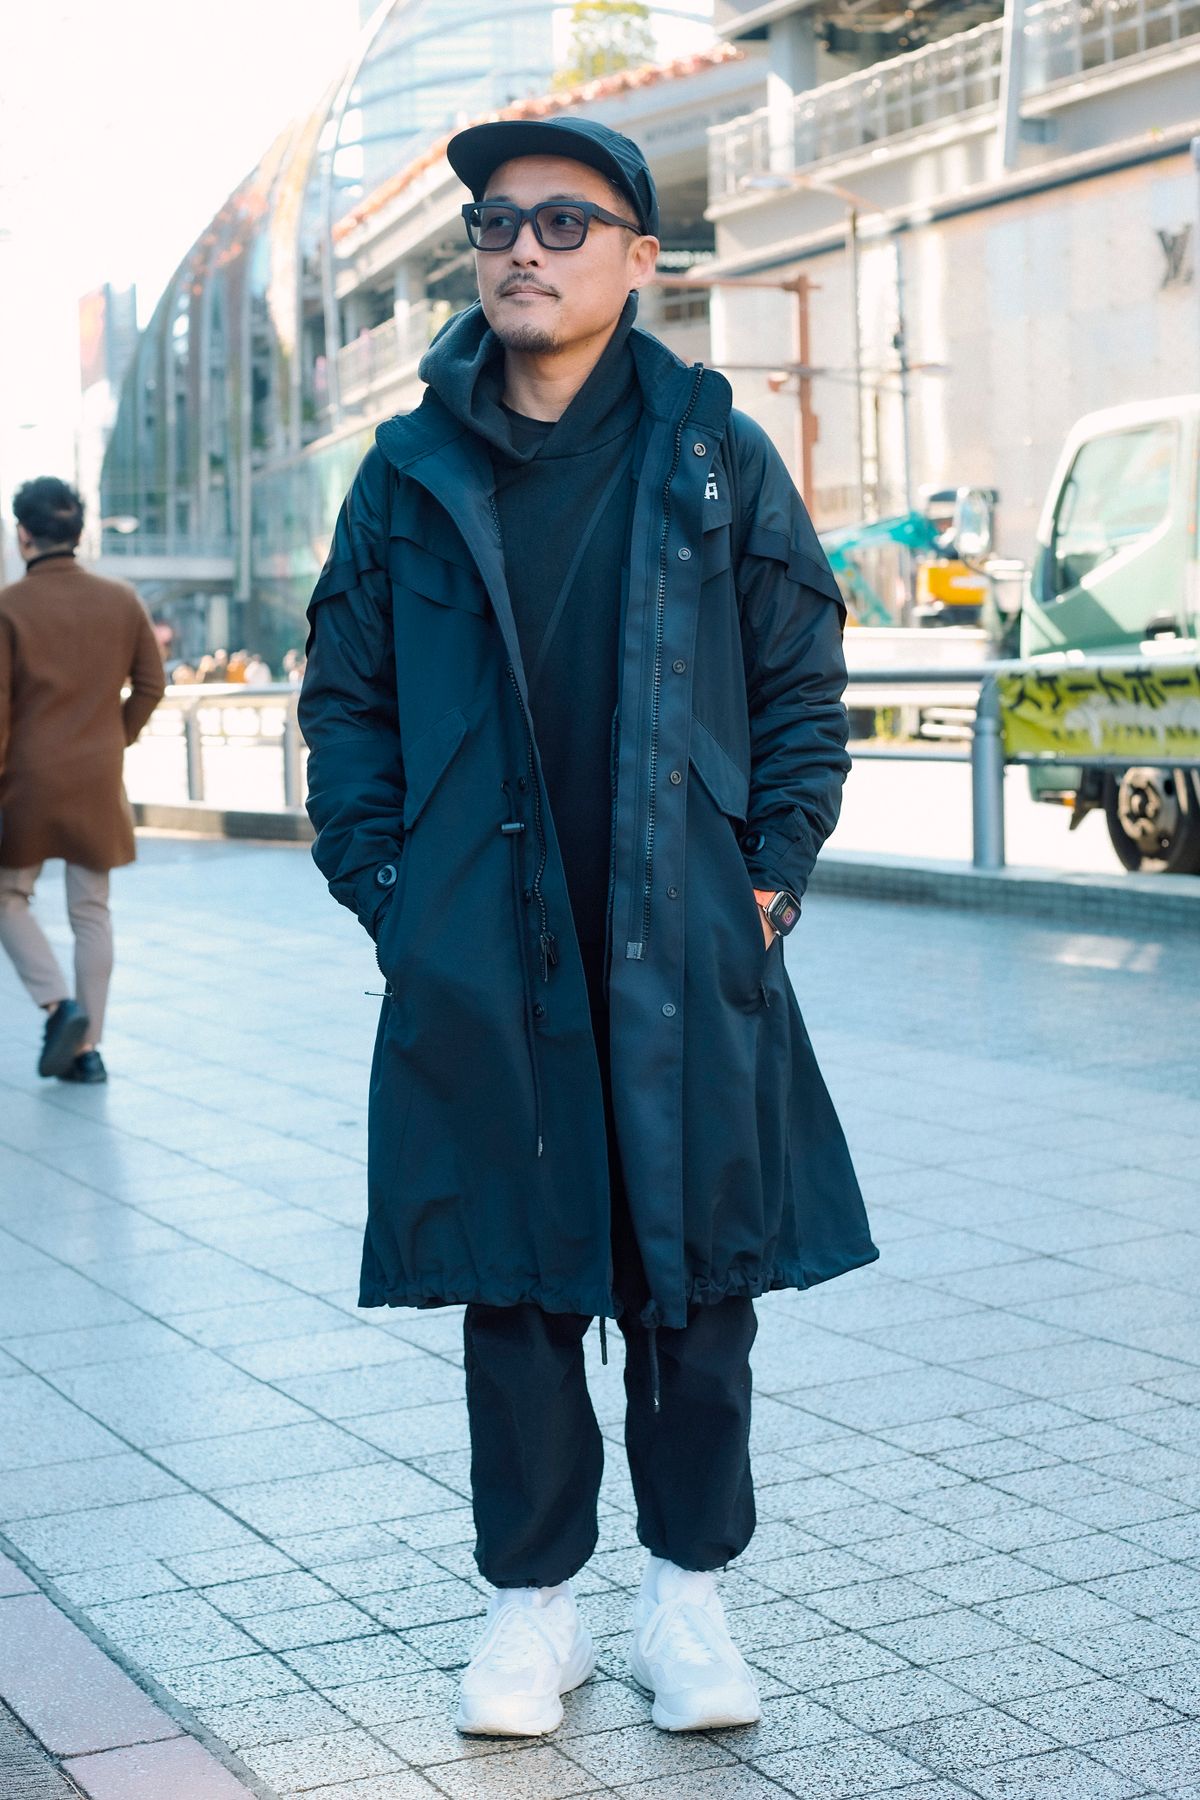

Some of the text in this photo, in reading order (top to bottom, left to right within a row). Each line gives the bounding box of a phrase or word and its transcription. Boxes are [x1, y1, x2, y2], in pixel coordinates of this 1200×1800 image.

[1007, 664, 1200, 711] スケートボー
